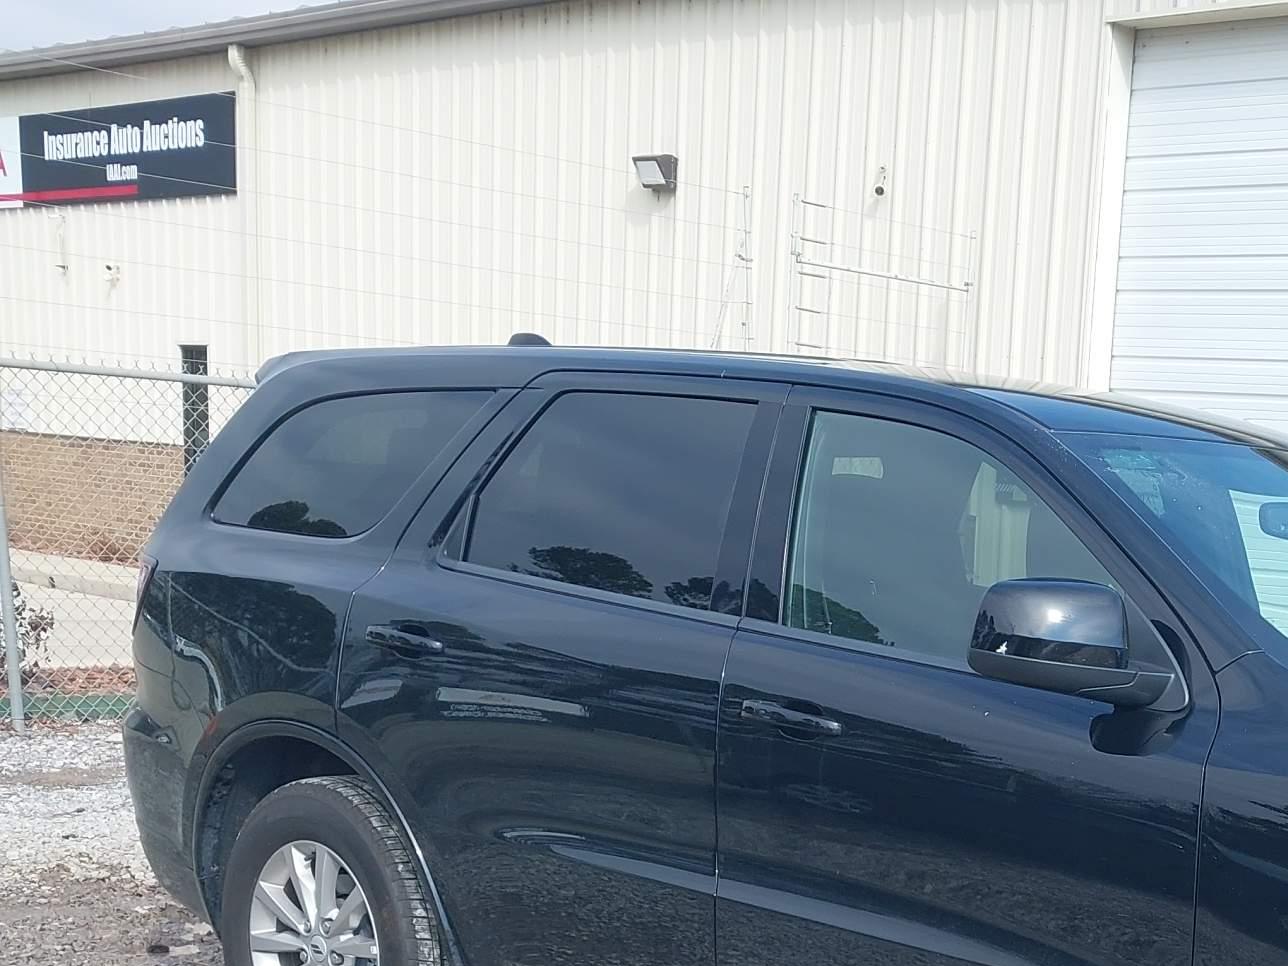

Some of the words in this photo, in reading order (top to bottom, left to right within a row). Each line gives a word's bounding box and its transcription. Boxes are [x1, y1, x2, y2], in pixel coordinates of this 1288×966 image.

[43, 128, 109, 161] Insurance
[110, 123, 141, 155] Auto
[143, 117, 205, 152] Auctions
[106, 163, 138, 182] IAAI.com
